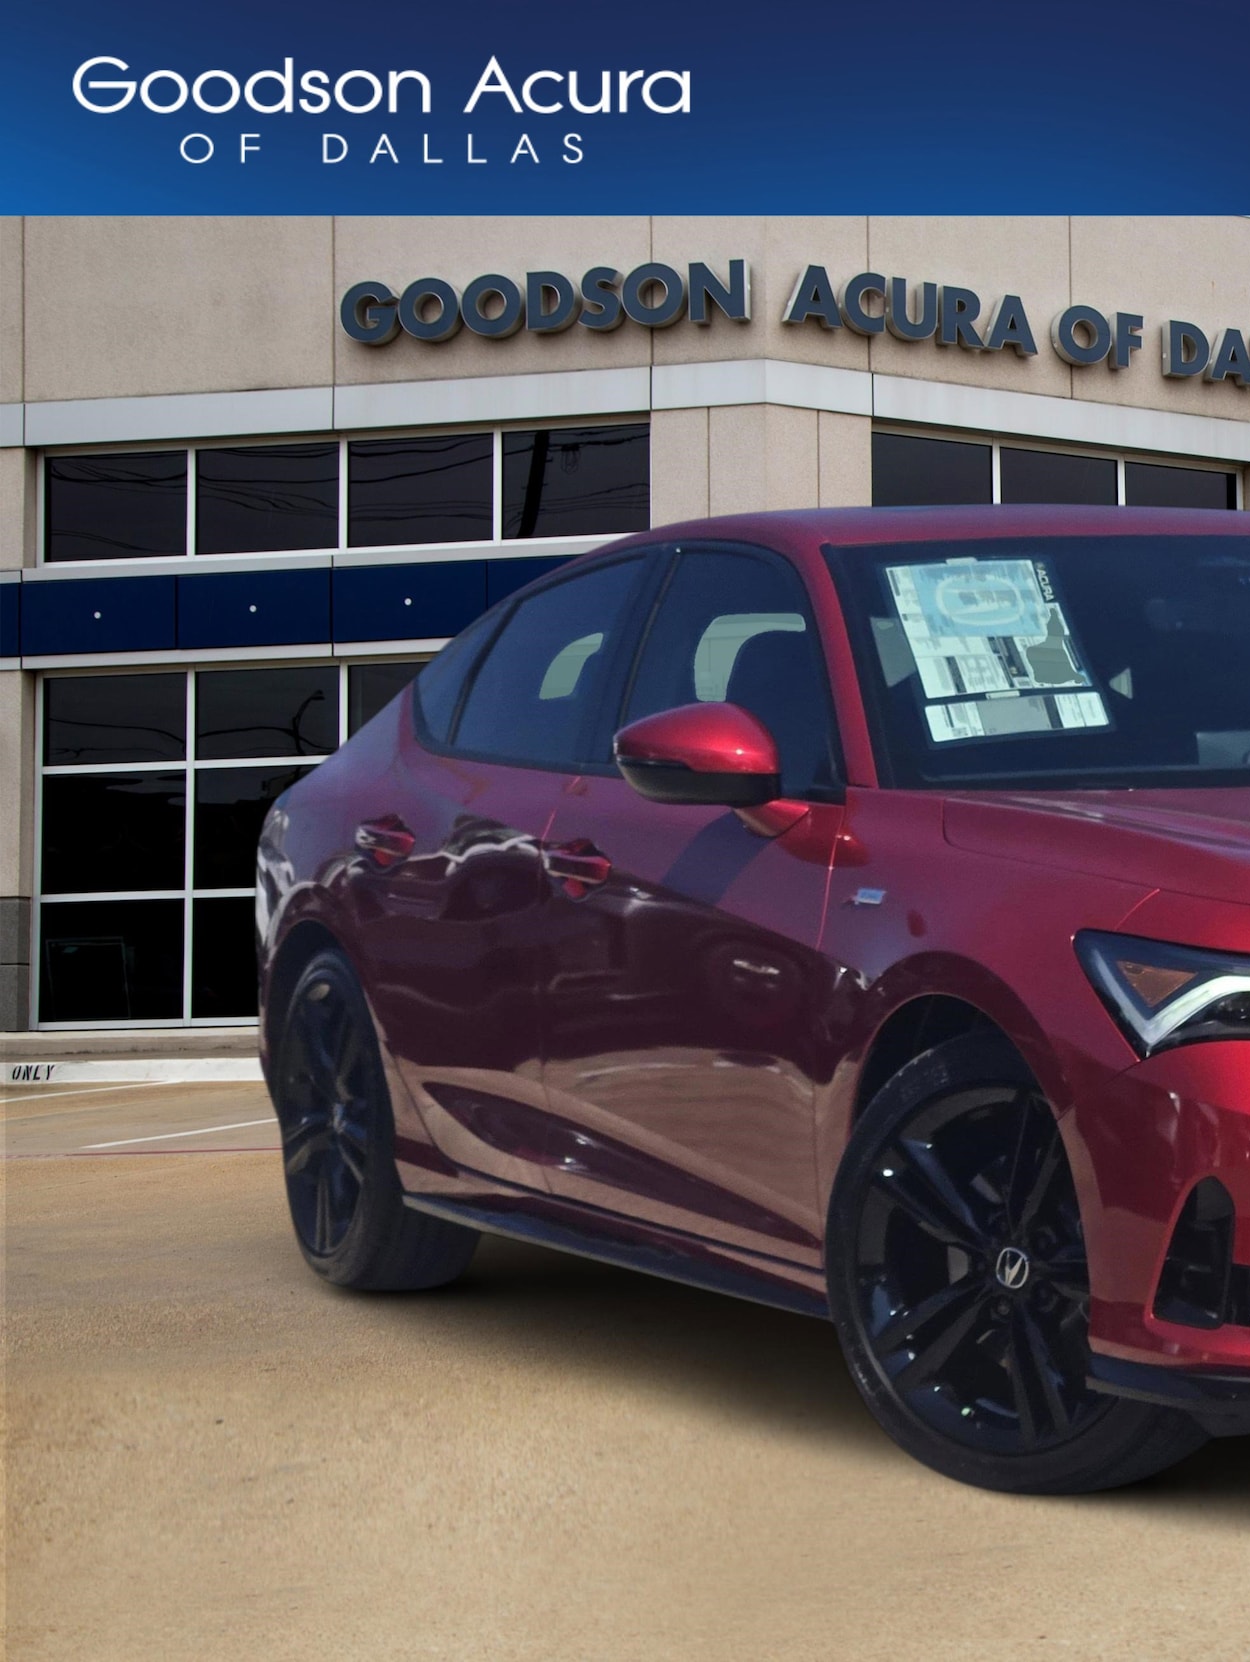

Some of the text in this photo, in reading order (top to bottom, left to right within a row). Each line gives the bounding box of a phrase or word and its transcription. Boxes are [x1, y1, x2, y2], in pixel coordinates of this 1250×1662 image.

[340, 258, 752, 346] GOODSON
[782, 264, 1038, 358] ACURA
[1052, 304, 1144, 371] OF
[1036, 568, 1055, 602] ACURA
[11, 1064, 55, 1081] ONLY
